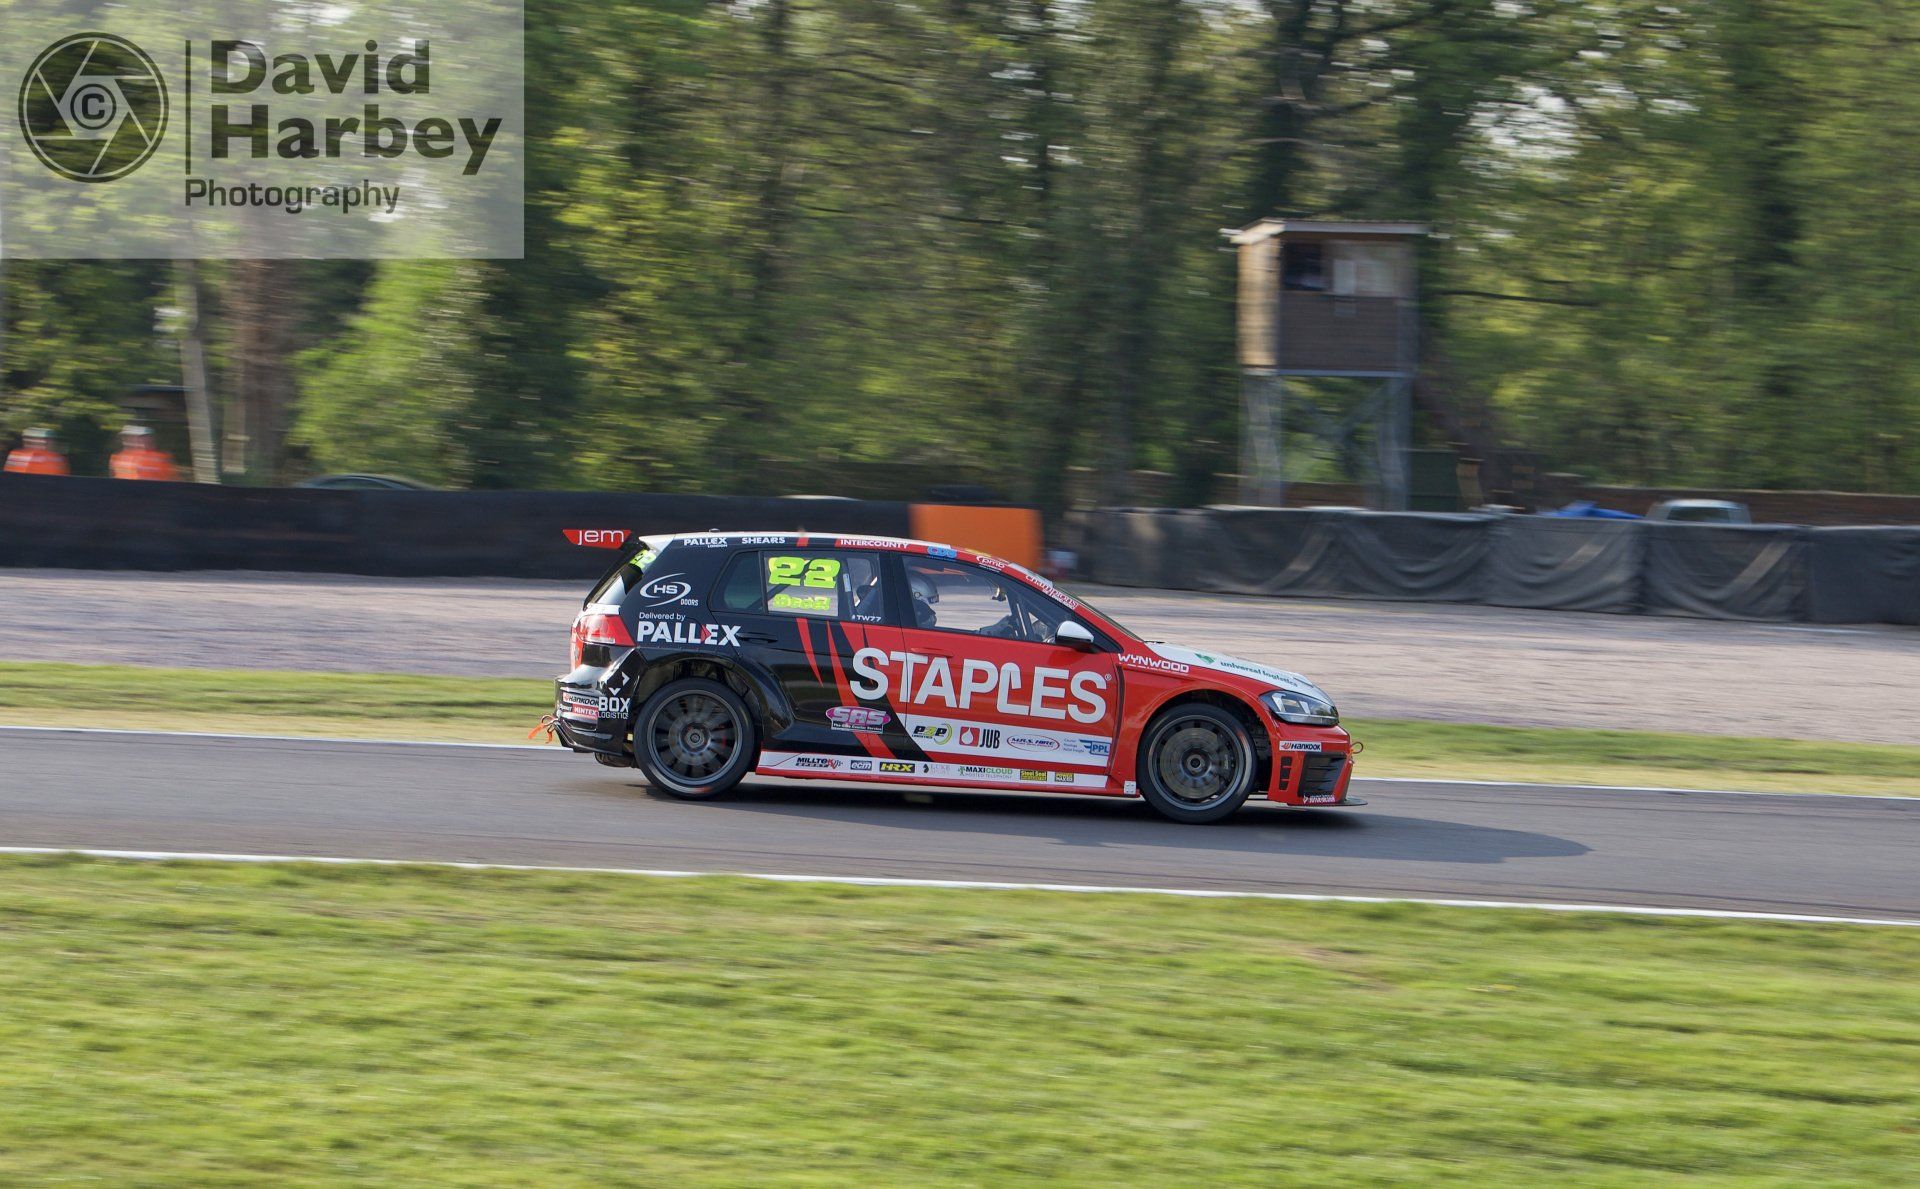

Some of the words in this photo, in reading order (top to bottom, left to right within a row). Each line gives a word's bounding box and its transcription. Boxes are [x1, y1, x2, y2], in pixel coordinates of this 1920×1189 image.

[578, 530, 625, 546] jem
[684, 537, 728, 545] PALLEX
[841, 539, 909, 548] INTERCOUNTY
[769, 556, 841, 589] 22
[653, 585, 678, 594] HS
[681, 599, 698, 607] DOORS
[639, 612, 674, 620] Delivered
[675, 613, 686, 621] by
[637, 621, 742, 647] PALLEX
[1118, 653, 1190, 673] WYNWOOD
[1221, 661, 1262, 675] universal
[1263, 670, 1298, 688] logistics
[849, 647, 1107, 724] STAPLES
[599, 697, 631, 713] BOX
[832, 707, 887, 725] SAS
[979, 728, 1001, 749] JUB
[1093, 744, 1109, 753] PPL
[881, 762, 913, 772] HRX
